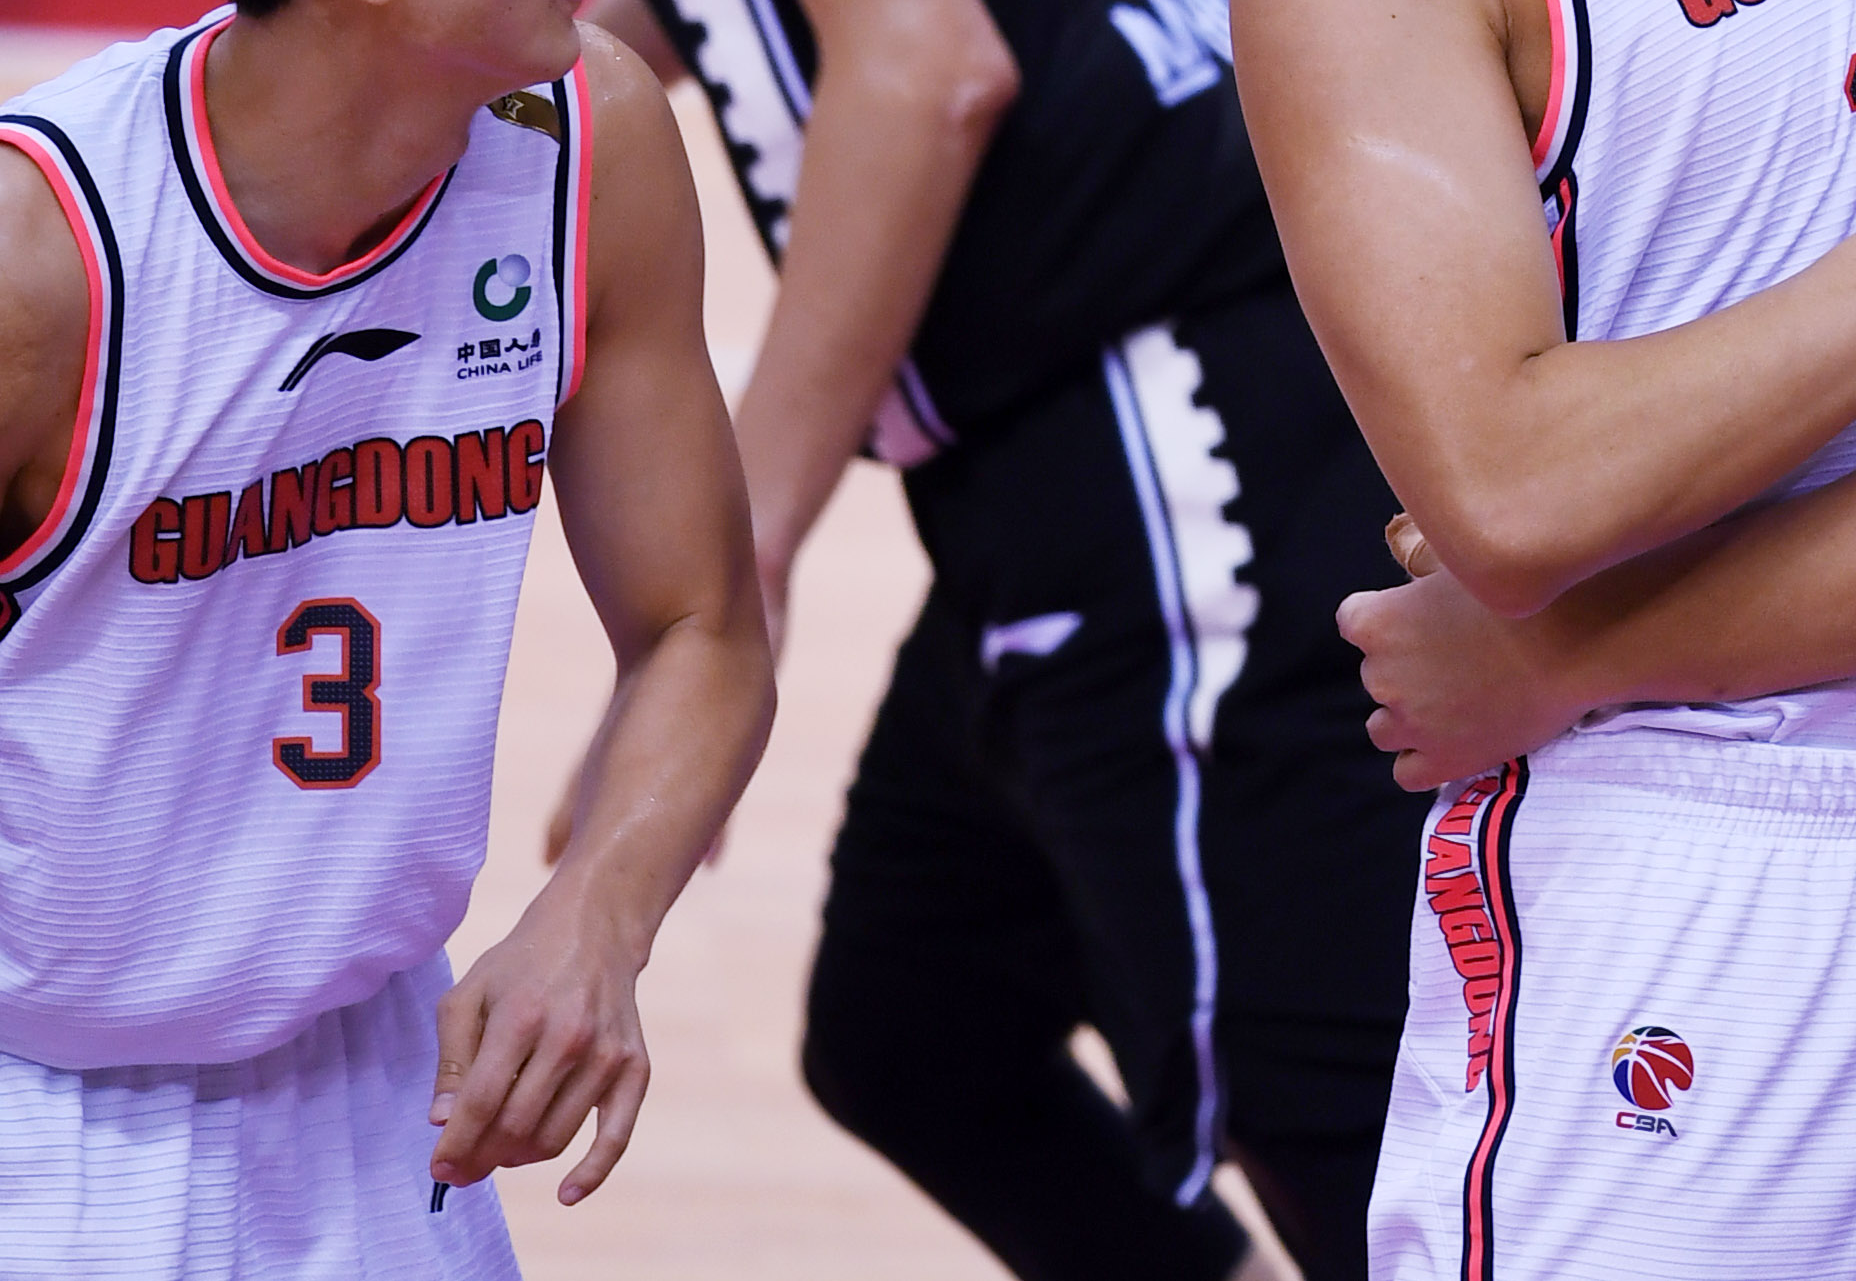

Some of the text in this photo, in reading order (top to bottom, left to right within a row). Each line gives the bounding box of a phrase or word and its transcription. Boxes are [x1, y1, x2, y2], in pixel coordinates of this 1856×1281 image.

[456, 350, 543, 379] CHINA LIFE
[128, 419, 546, 584] GUANGDONG
[272, 597, 381, 790] 3
[1615, 1111, 1678, 1138] CBA
